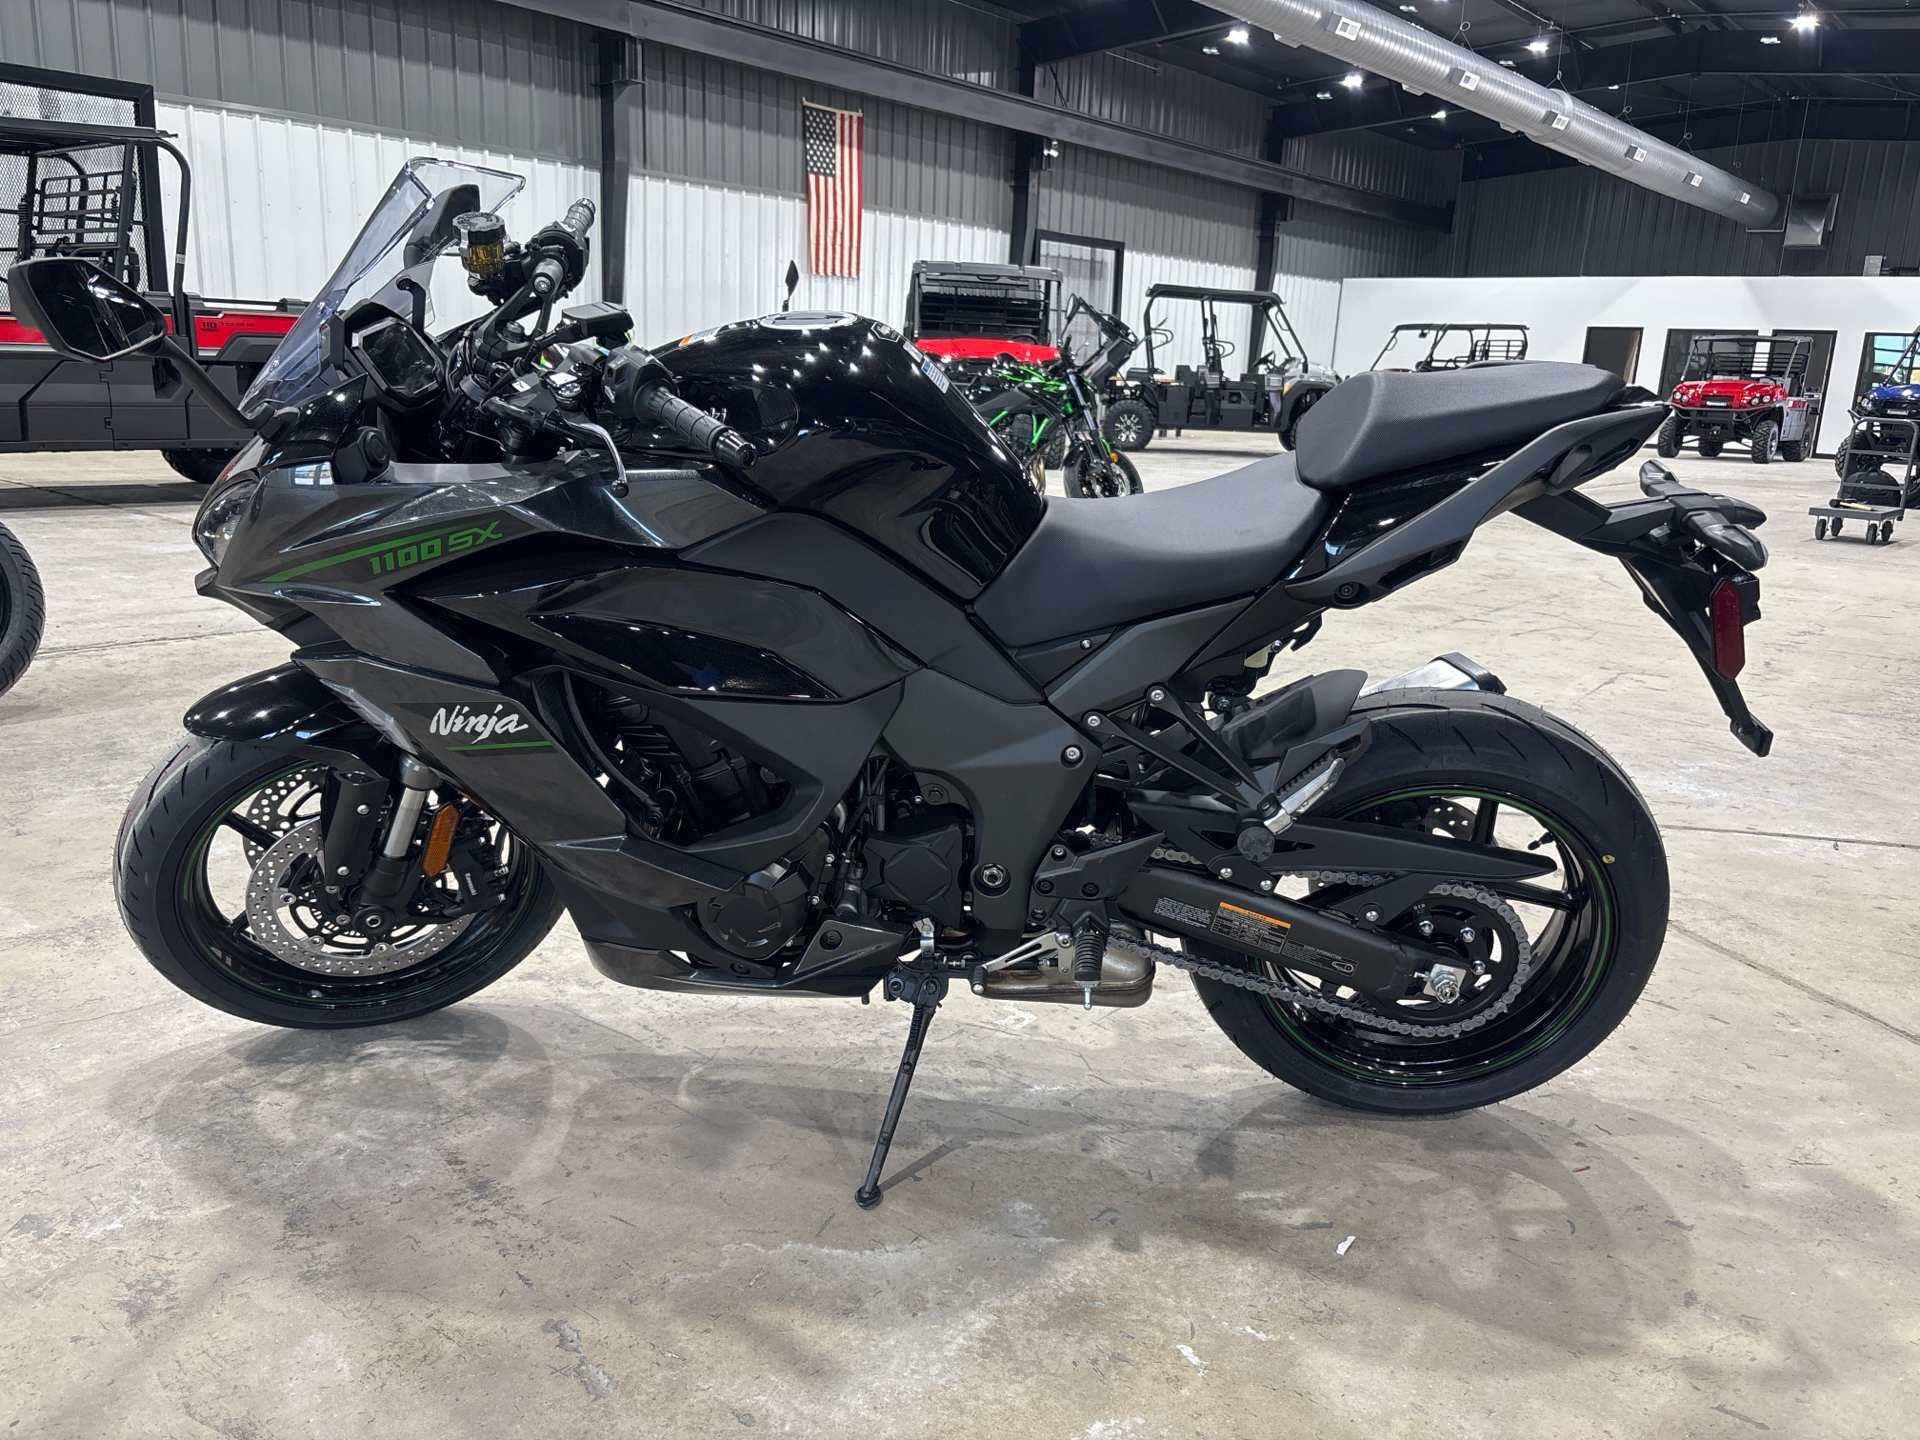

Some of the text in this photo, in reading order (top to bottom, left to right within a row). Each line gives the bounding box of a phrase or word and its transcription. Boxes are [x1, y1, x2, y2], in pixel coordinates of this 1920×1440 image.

[369, 520, 503, 575] 1100 SX
[429, 703, 530, 745] Ninja
[464, 872, 478, 896] Kawasaki
